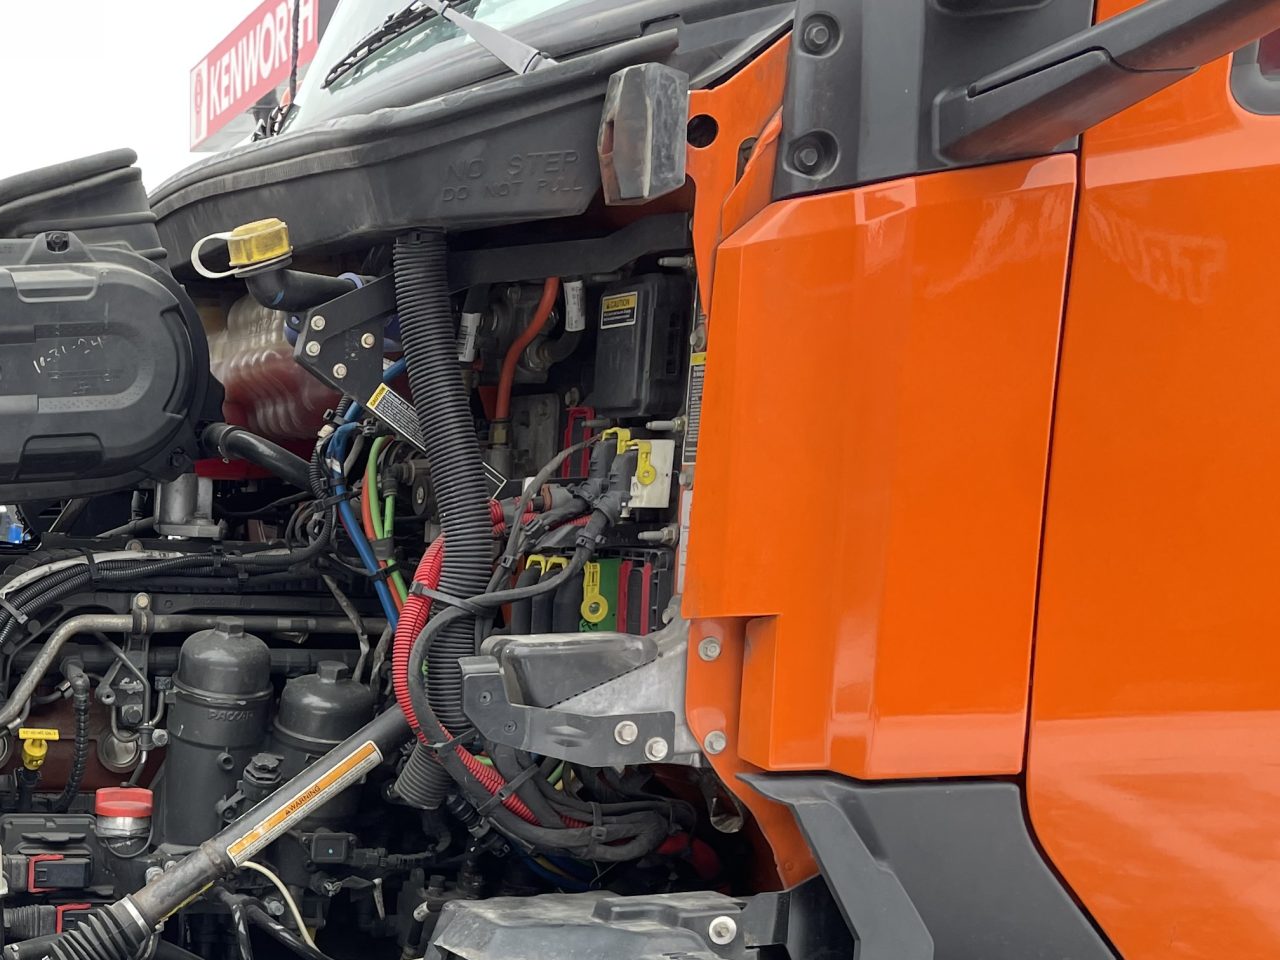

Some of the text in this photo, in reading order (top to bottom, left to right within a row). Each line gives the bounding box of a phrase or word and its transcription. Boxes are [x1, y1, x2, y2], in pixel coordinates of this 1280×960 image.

[210, 0, 313, 120] KENWORTH
[446, 149, 581, 181] NO STEP
[289, 784, 322, 813] WARNING
